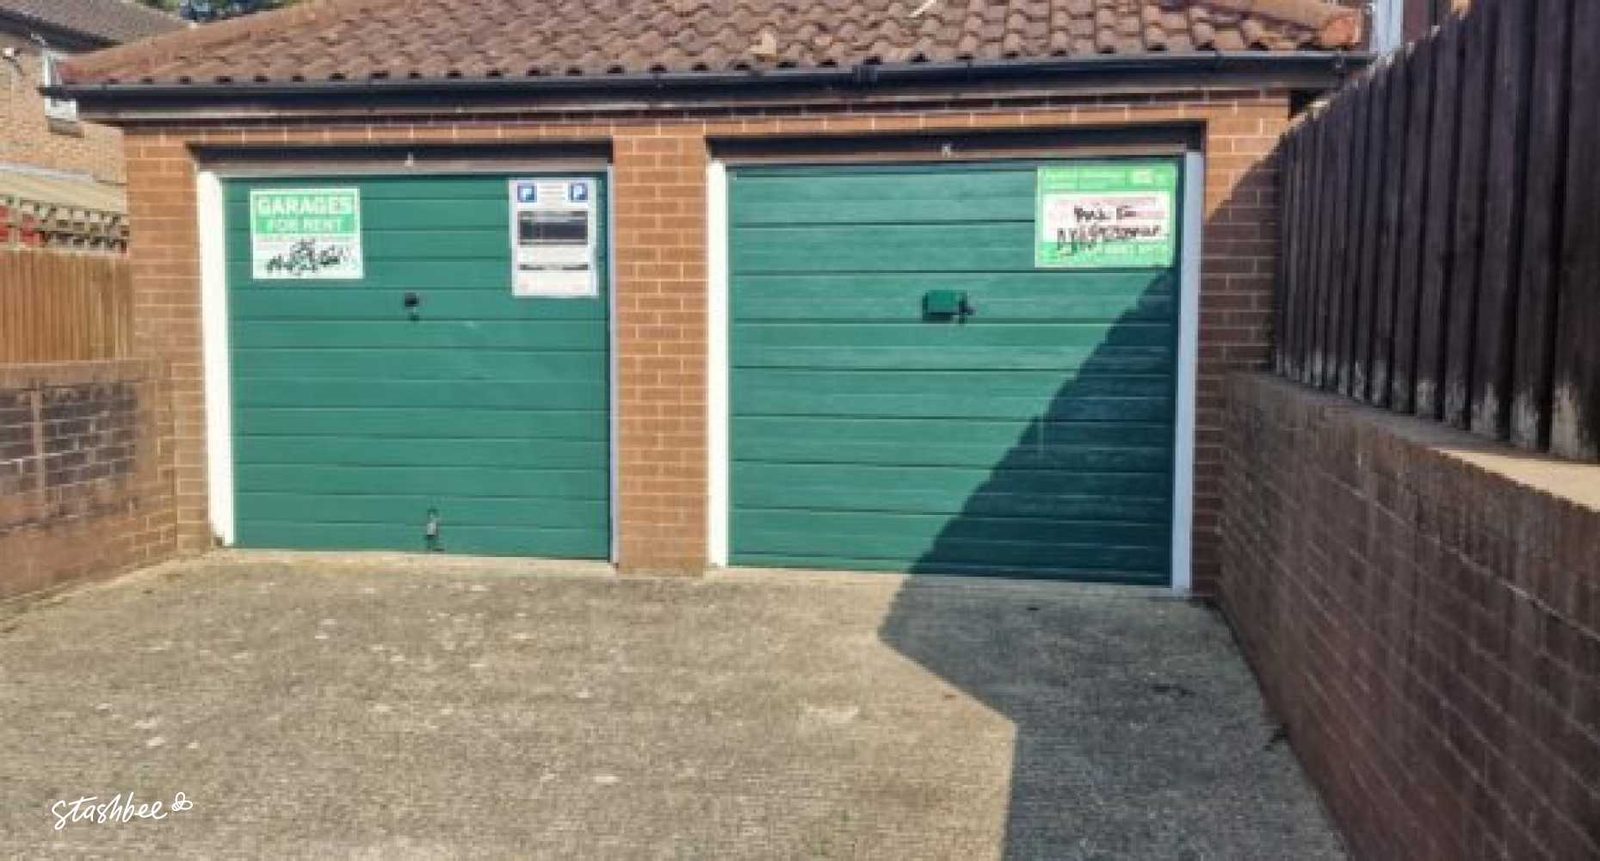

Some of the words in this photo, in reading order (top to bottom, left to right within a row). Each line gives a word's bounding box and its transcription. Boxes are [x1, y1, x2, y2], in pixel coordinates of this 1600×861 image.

[257, 195, 353, 214] GARAGES
[266, 218, 300, 233] FOR
[303, 217, 343, 233] RENT
